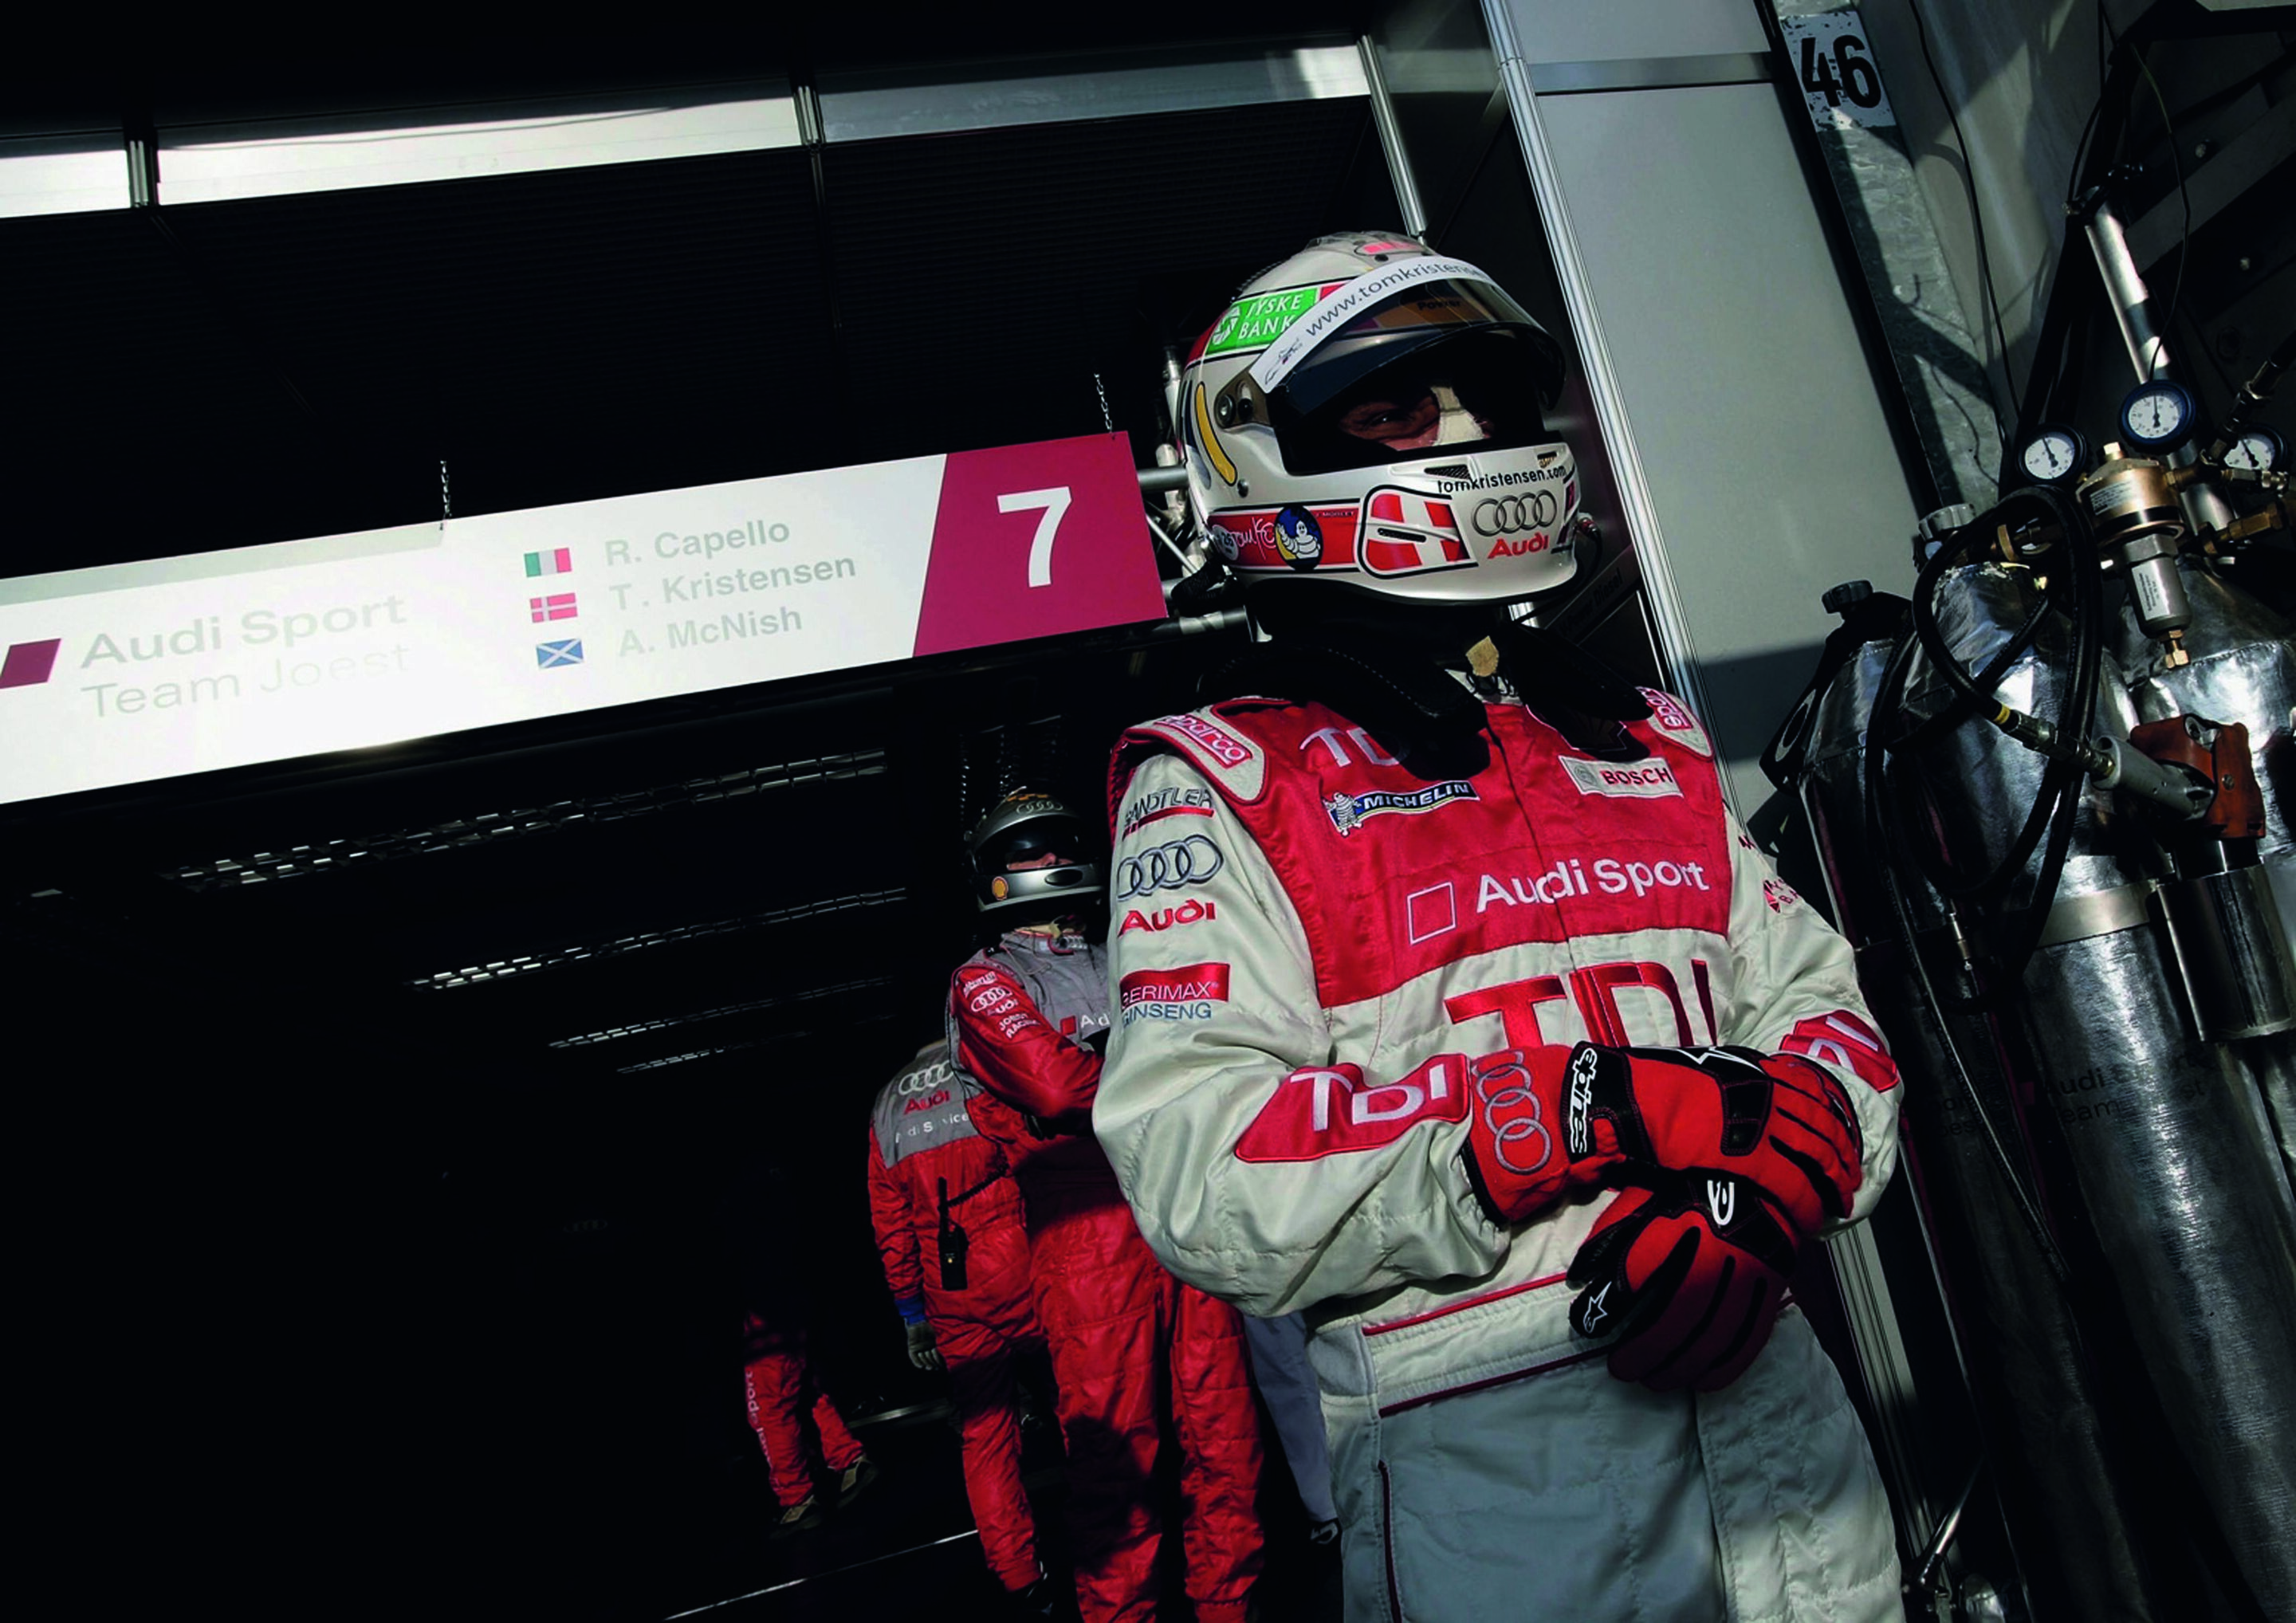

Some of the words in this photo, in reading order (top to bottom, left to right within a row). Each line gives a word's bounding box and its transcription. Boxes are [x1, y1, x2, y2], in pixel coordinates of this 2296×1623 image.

[1801, 34, 1881, 108] 46
[1437, 465, 1567, 493] tomkristensen.com
[604, 537, 643, 567] R.
[654, 520, 791, 561] Capello
[996, 485, 1072, 588] 7
[1487, 532, 1550, 560] Audi
[662, 553, 857, 605] Kristensen
[81, 618, 222, 669] Audi
[242, 593, 408, 648] Sport
[617, 631, 655, 658] A.
[668, 606, 804, 650] McNish
[81, 670, 240, 718] Team
[259, 644, 411, 694] Joest
[1299, 726, 1412, 768] TD
[1363, 783, 1470, 810] MICHELIN
[1599, 767, 1673, 785] BOSCH
[1476, 859, 1589, 916] Audi
[1595, 858, 1712, 906] Sport
[1117, 898, 1217, 938] Audi
[1445, 959, 1718, 1049] TDI
[903, 1089, 951, 1116] Audi
[1289, 1063, 1449, 1133] TDI
